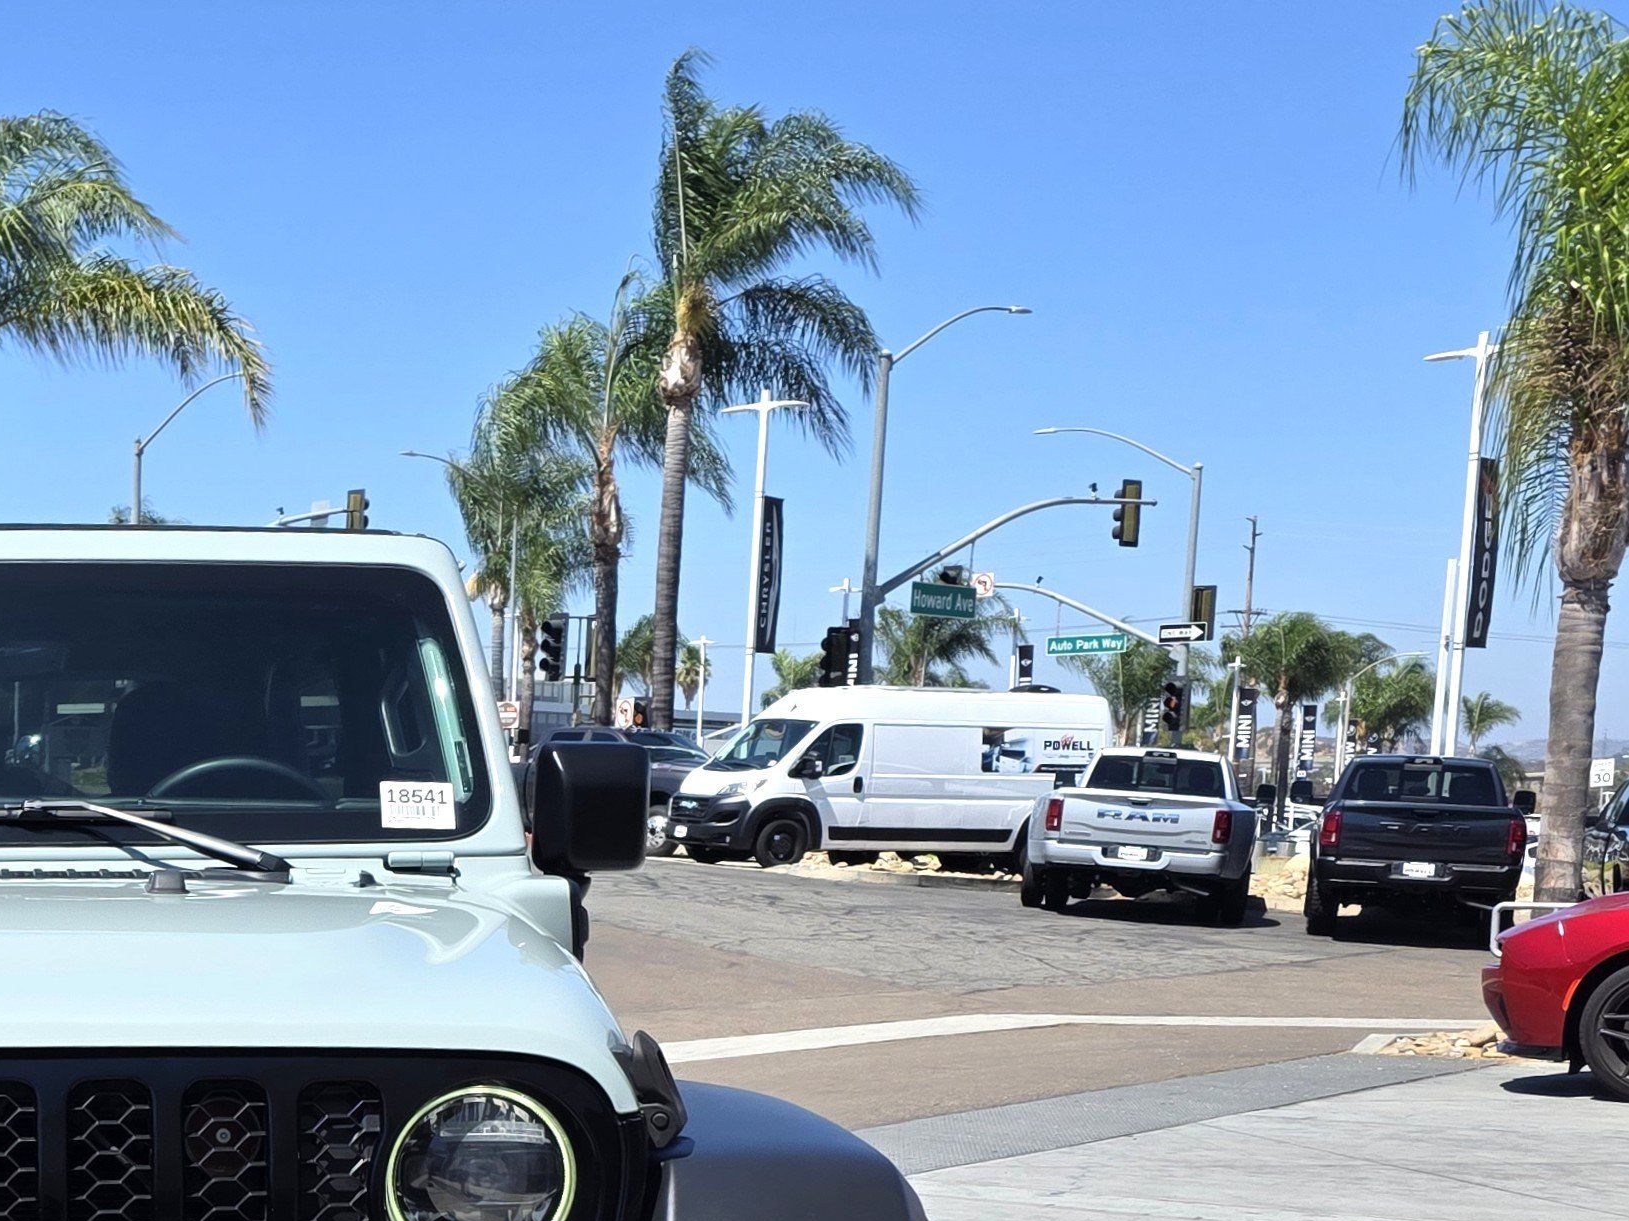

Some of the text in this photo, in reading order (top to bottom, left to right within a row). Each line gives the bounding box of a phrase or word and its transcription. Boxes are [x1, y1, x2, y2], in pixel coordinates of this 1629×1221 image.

[760, 521, 772, 629] CHRYSLER
[913, 588, 974, 612] Howard Ave
[1049, 638, 1123, 652] Auto Park Way
[1236, 714, 1252, 748] MINI
[1043, 740, 1094, 751] POWELL
[1300, 729, 1315, 760] MINI
[1594, 773, 1611, 784] 30
[387, 788, 447, 804] 18541
[1096, 808, 1180, 824] RAM
